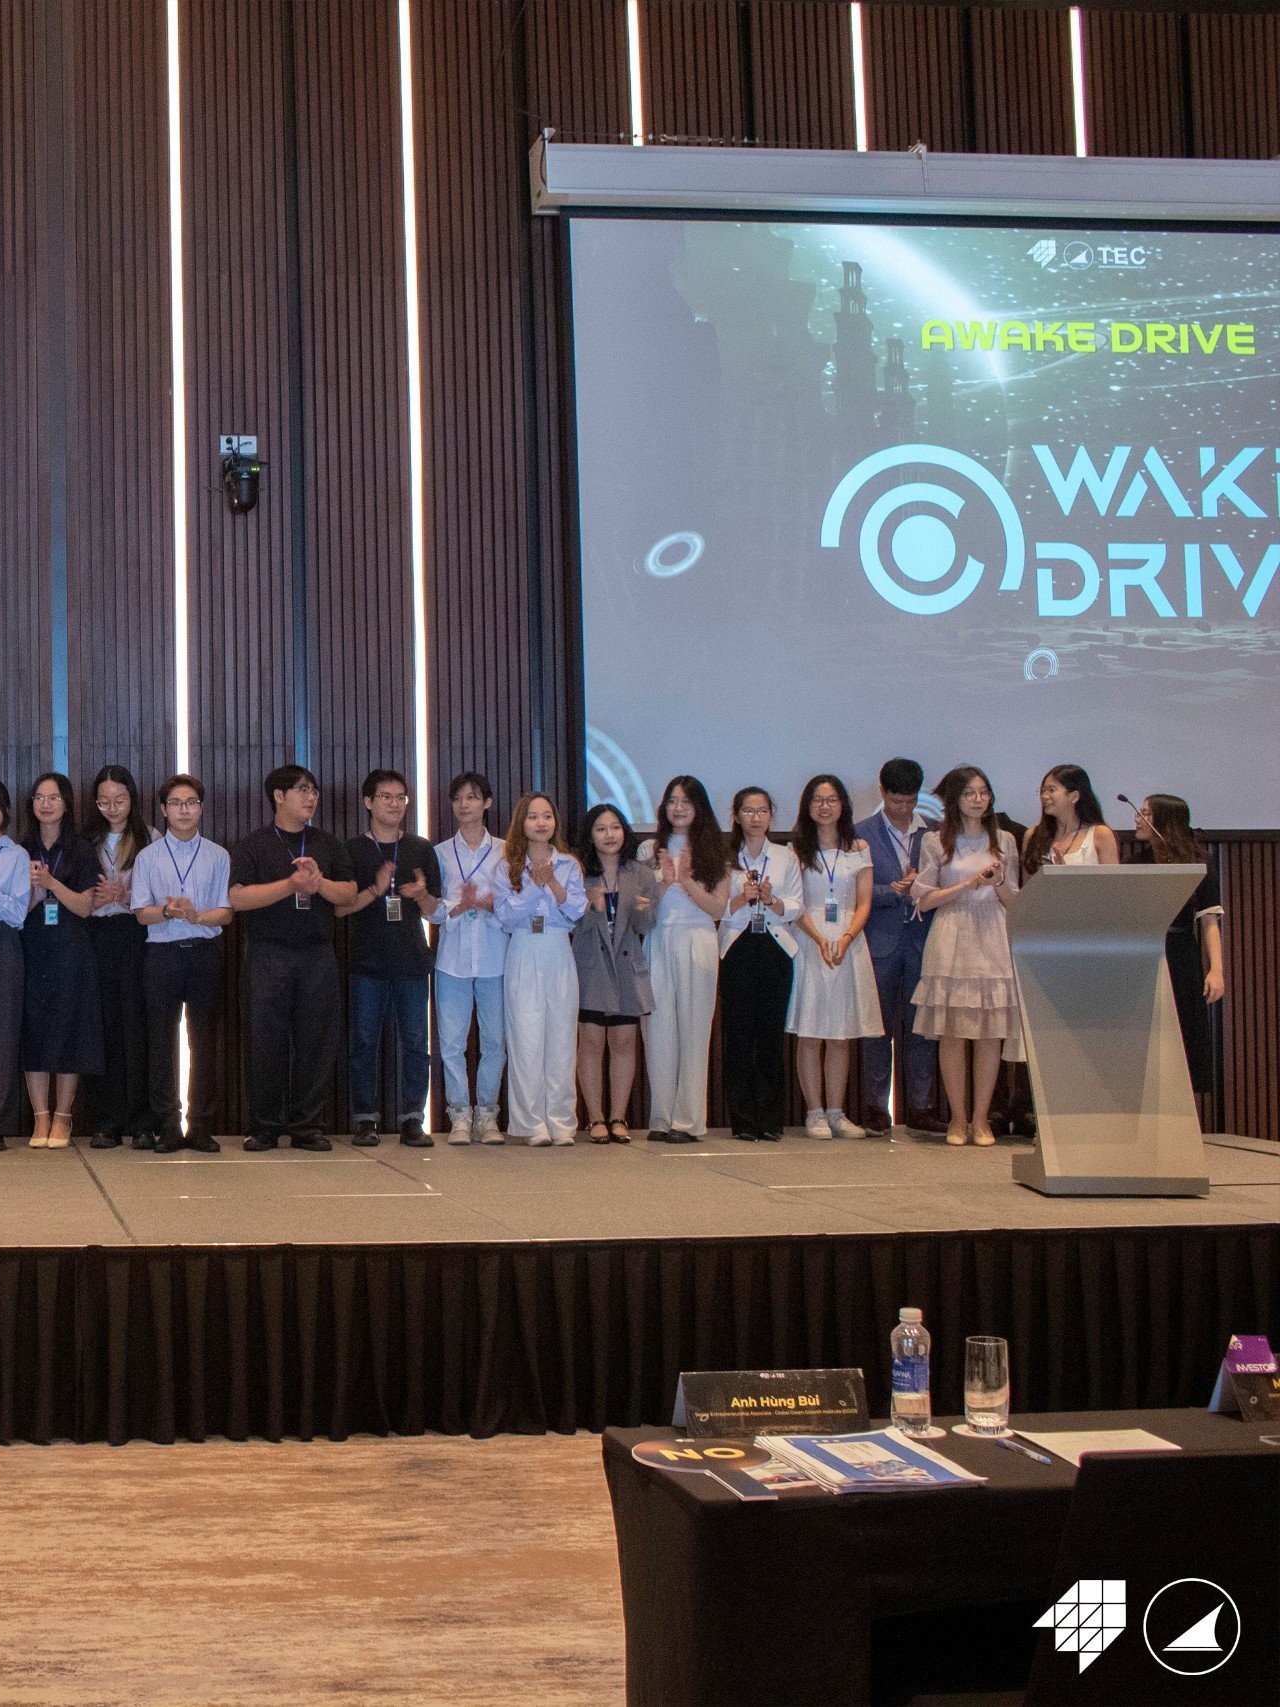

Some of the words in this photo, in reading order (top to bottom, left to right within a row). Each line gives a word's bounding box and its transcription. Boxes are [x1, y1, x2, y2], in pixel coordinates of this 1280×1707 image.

[1097, 246, 1146, 265] TEC
[921, 320, 1096, 352] AWAKE
[1111, 322, 1256, 355] DRIVE
[1031, 444, 1280, 518] WAK
[731, 1396, 757, 1408] Anh
[760, 1395, 795, 1409] Hùng
[798, 1394, 820, 1407] Bùi
[658, 1447, 746, 1461] NO
